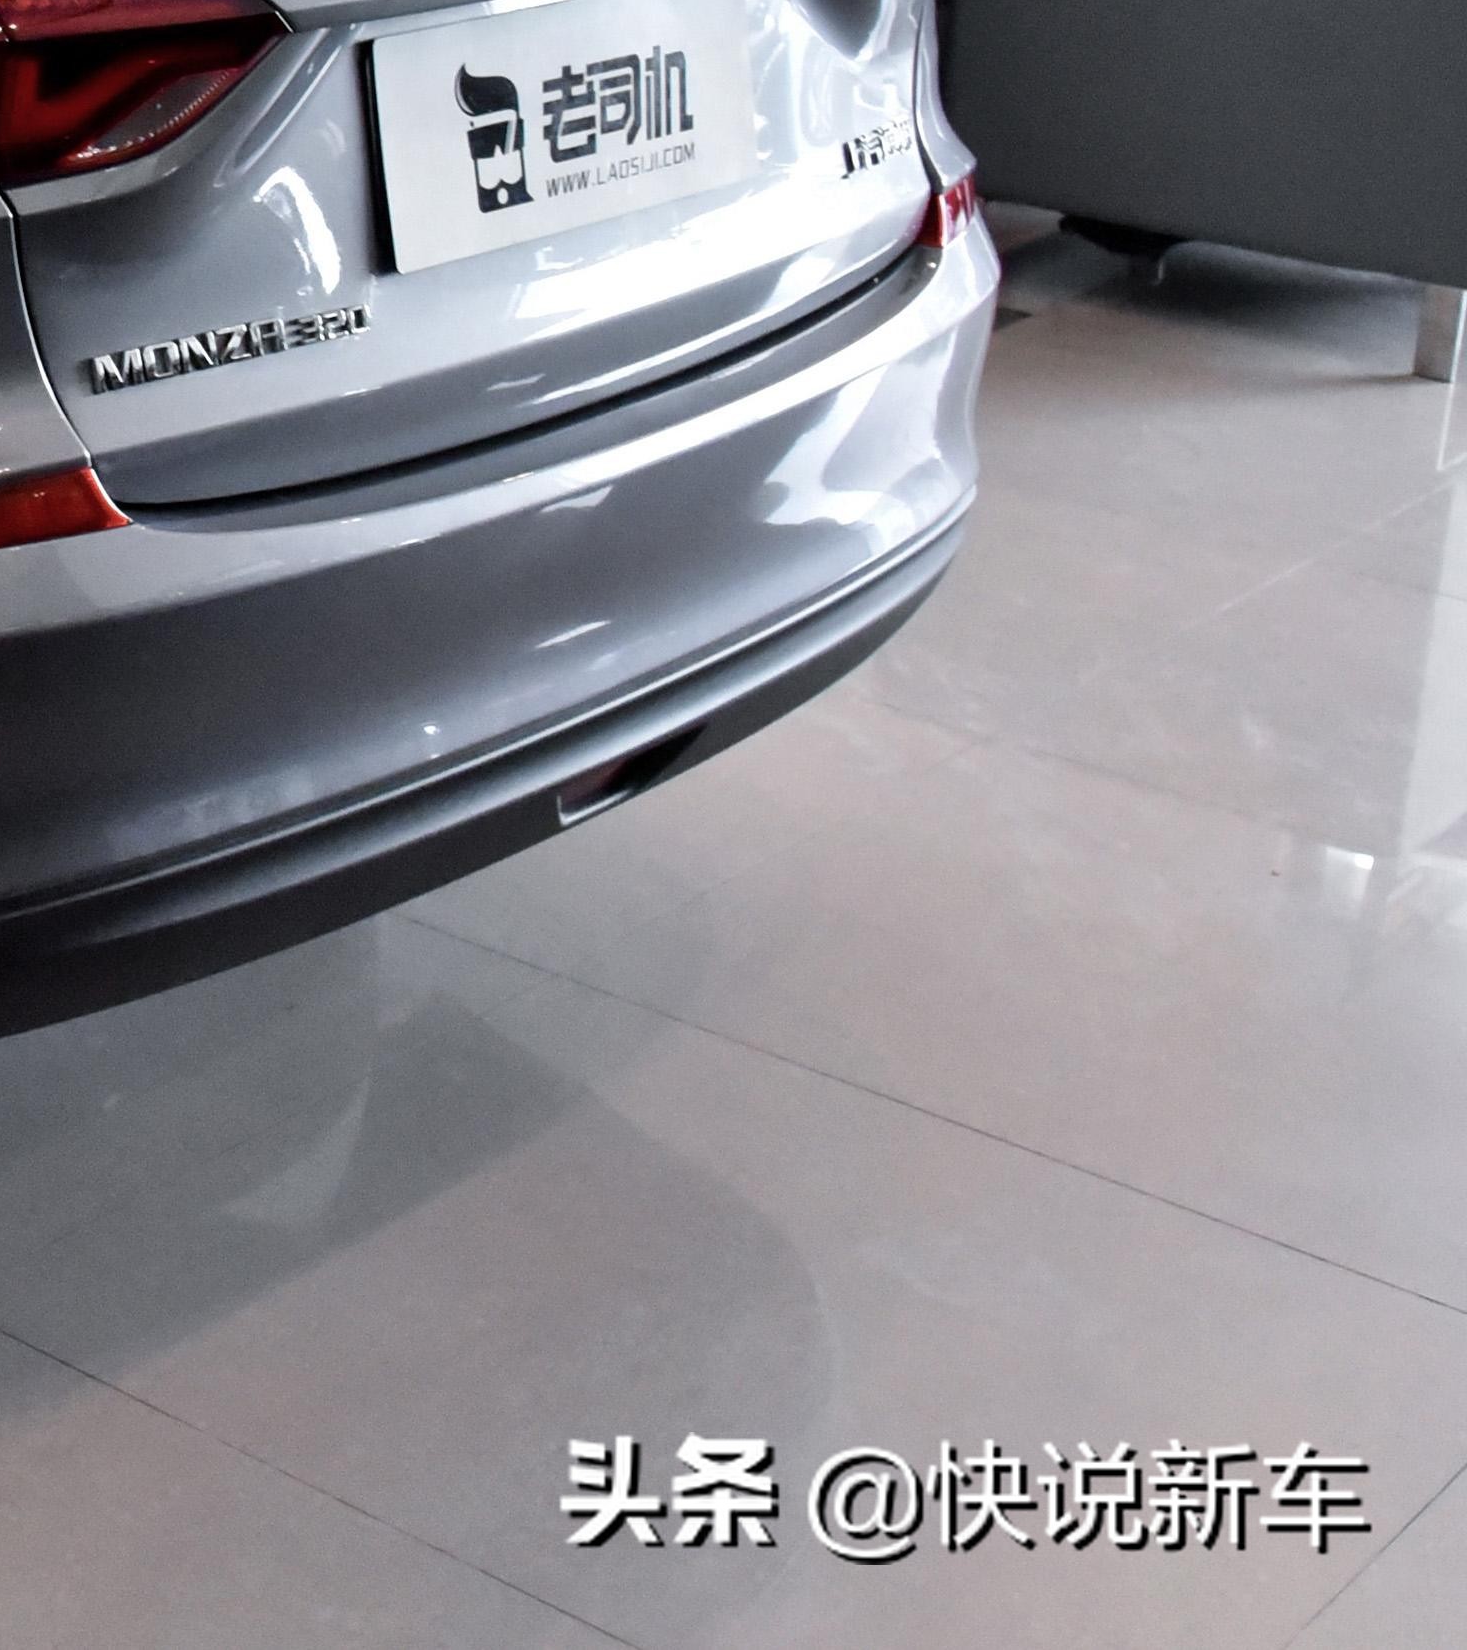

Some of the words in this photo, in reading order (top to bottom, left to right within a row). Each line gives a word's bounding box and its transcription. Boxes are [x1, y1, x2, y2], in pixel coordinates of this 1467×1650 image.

[542, 45, 695, 163] 老司机
[546, 142, 696, 198] WWW.LAOSIJI.COM
[90, 317, 289, 395] MONZA
